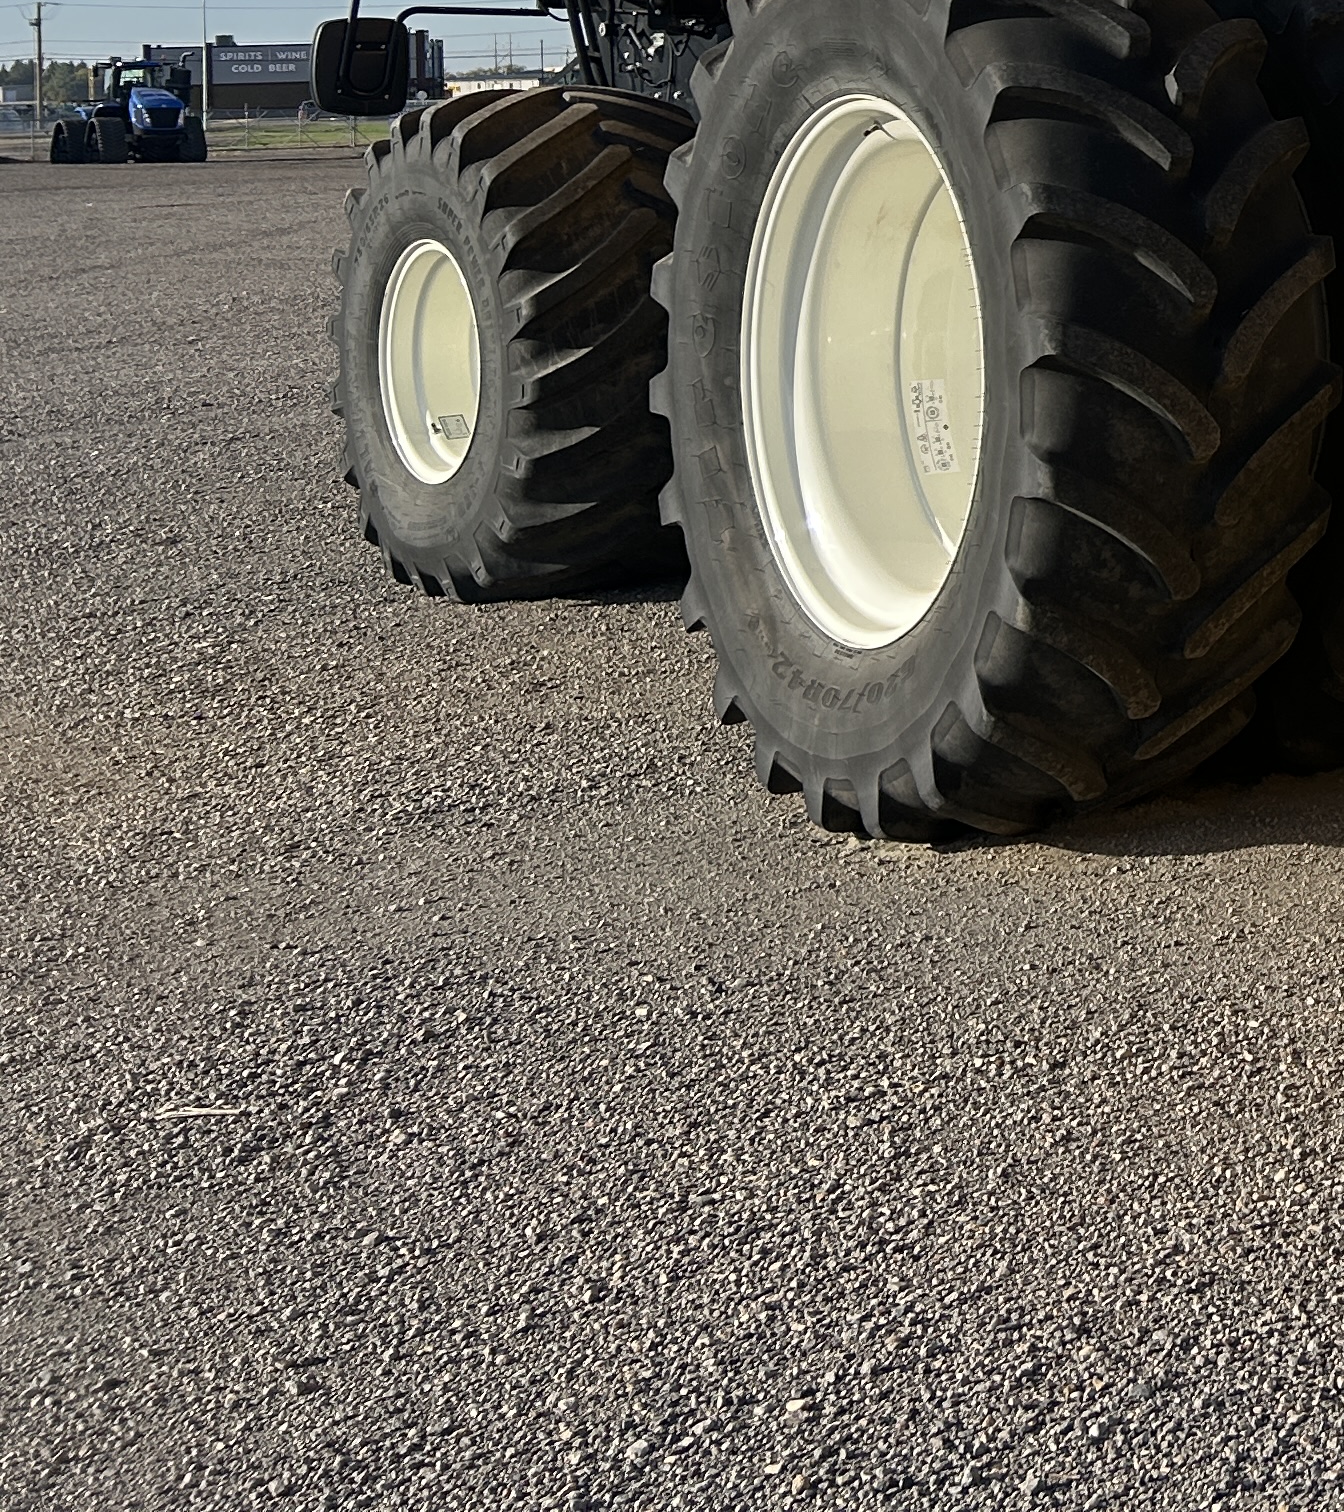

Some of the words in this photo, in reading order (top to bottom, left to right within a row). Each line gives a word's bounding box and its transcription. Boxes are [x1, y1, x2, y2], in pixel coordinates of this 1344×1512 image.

[219, 51, 263, 61] SPIRITS
[275, 51, 308, 60] WINE
[231, 64, 262, 73] COLD
[268, 63, 297, 72] BEER
[436, 196, 464, 236] SUPER
